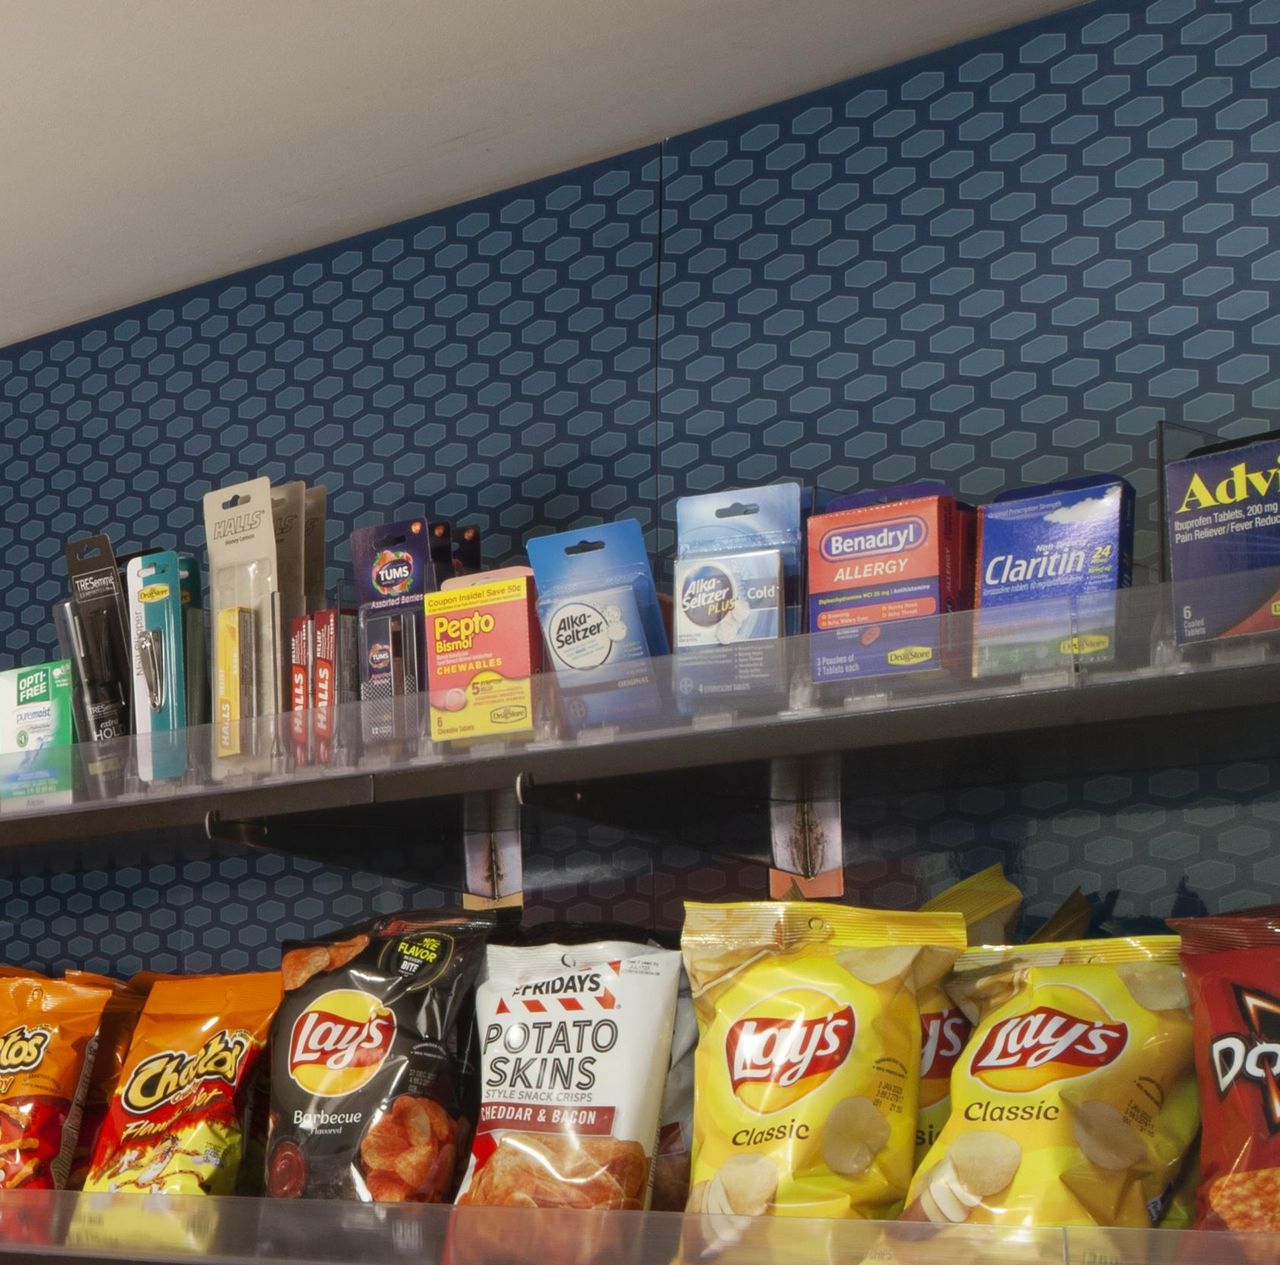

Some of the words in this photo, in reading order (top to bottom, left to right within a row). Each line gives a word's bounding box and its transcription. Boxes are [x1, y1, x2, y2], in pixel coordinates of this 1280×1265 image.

[1176, 456, 1280, 513] Adv
[214, 510, 263, 540] HALLS
[1174, 515, 1211, 532] Ibuprofen
[1213, 510, 1245, 523] Tablets,
[1246, 503, 1263, 517] 200
[1264, 502, 1279, 516] mg
[831, 523, 914, 555] Benadryl
[1175, 531, 1193, 544] Pain
[1254, 514, 1280, 530] Reduc
[378, 566, 409, 583] TUMS
[833, 558, 909, 582] ALLERGY
[985, 548, 1085, 585] Claritin
[1092, 545, 1112, 560] 24
[428, 595, 457, 608] Coupon
[458, 591, 485, 602] Inside!
[486, 587, 505, 598] Save
[682, 587, 729, 611] Seltzer
[685, 578, 721, 598] Alka-
[747, 585, 776, 600] Cold
[707, 598, 737, 616] PLUS
[1183, 605, 1192, 620] 6
[433, 611, 495, 641] Pepto
[556, 612, 592, 635] Alka-
[556, 621, 604, 649] Seltzer
[372, 651, 390, 661] TUMS
[435, 636, 473, 654] Bismol
[889, 648, 931, 663] DrugStore
[436, 656, 503, 675] CHEWABLES
[19, 671, 46, 691] OPTI-
[19, 682, 47, 703] FREE
[471, 681, 480, 696] 5
[293, 672, 304, 734] HALLS
[316, 667, 330, 730] HALLS
[398, 942, 438, 963] FLAVOR
[401, 961, 420, 973] BITE
[293, 1008, 389, 1070] Lay's
[483, 1018, 618, 1055] POTATO
[977, 1006, 1121, 1069] Lay's
[734, 1012, 850, 1087] Lay's
[486, 1056, 597, 1091] SKINS
[485, 1089, 516, 1100] STYLE
[517, 1090, 553, 1102] SNACK
[556, 1091, 593, 1103] CRISPS
[293, 1109, 362, 1126] Barbecue
[481, 1105, 531, 1121] CHEDDAR
[536, 1108, 547, 1122] &
[551, 1109, 597, 1125] BACON
[964, 1100, 1060, 1123] Classic
[732, 1117, 810, 1147] Classic
